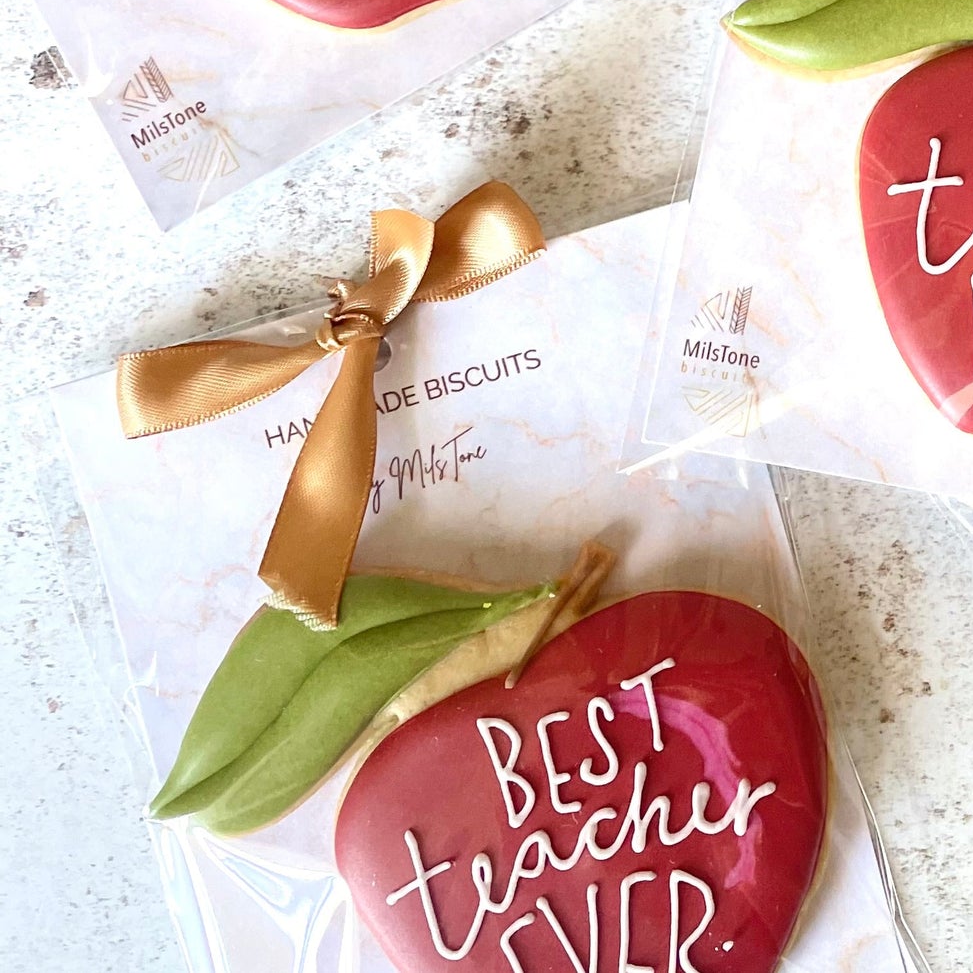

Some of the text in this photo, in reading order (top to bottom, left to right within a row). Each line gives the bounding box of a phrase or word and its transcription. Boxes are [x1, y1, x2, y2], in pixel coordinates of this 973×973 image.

[130, 100, 207, 149] MilsTone
[424, 348, 542, 401] BISCUITS
[682, 338, 761, 369] MilsTone
[475, 656, 677, 829] BEST
[385, 760, 778, 962] teacher
